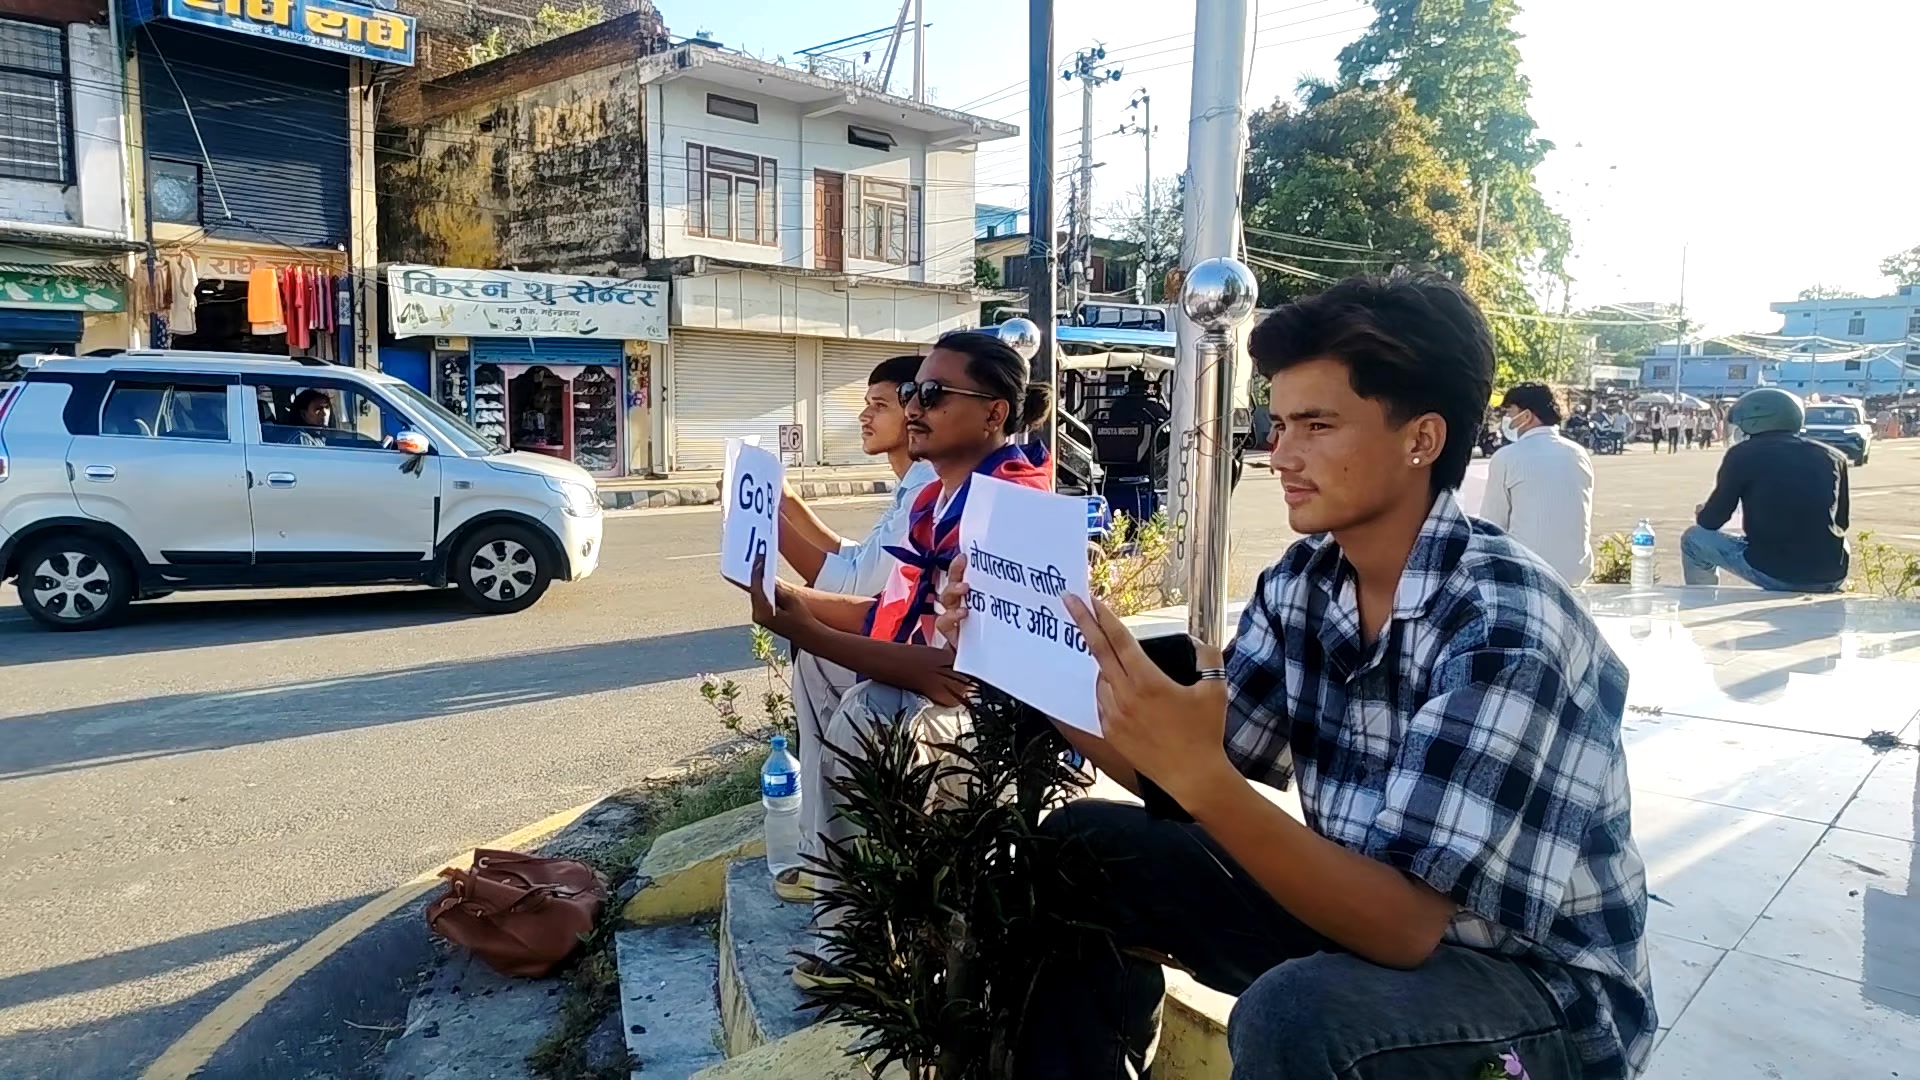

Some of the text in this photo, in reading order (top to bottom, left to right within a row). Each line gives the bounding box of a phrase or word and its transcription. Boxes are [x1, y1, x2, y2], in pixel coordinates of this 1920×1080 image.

[305, 6, 408, 49] राधे
[210, 256, 257, 275] राधे
[523, 282, 557, 305] शु
[568, 280, 659, 307] सेन्टर
[739, 473, 763, 514] Go
[970, 540, 1026, 586] नेपालका
[990, 595, 1021, 629] भएर
[1026, 605, 1058, 642] अघि
